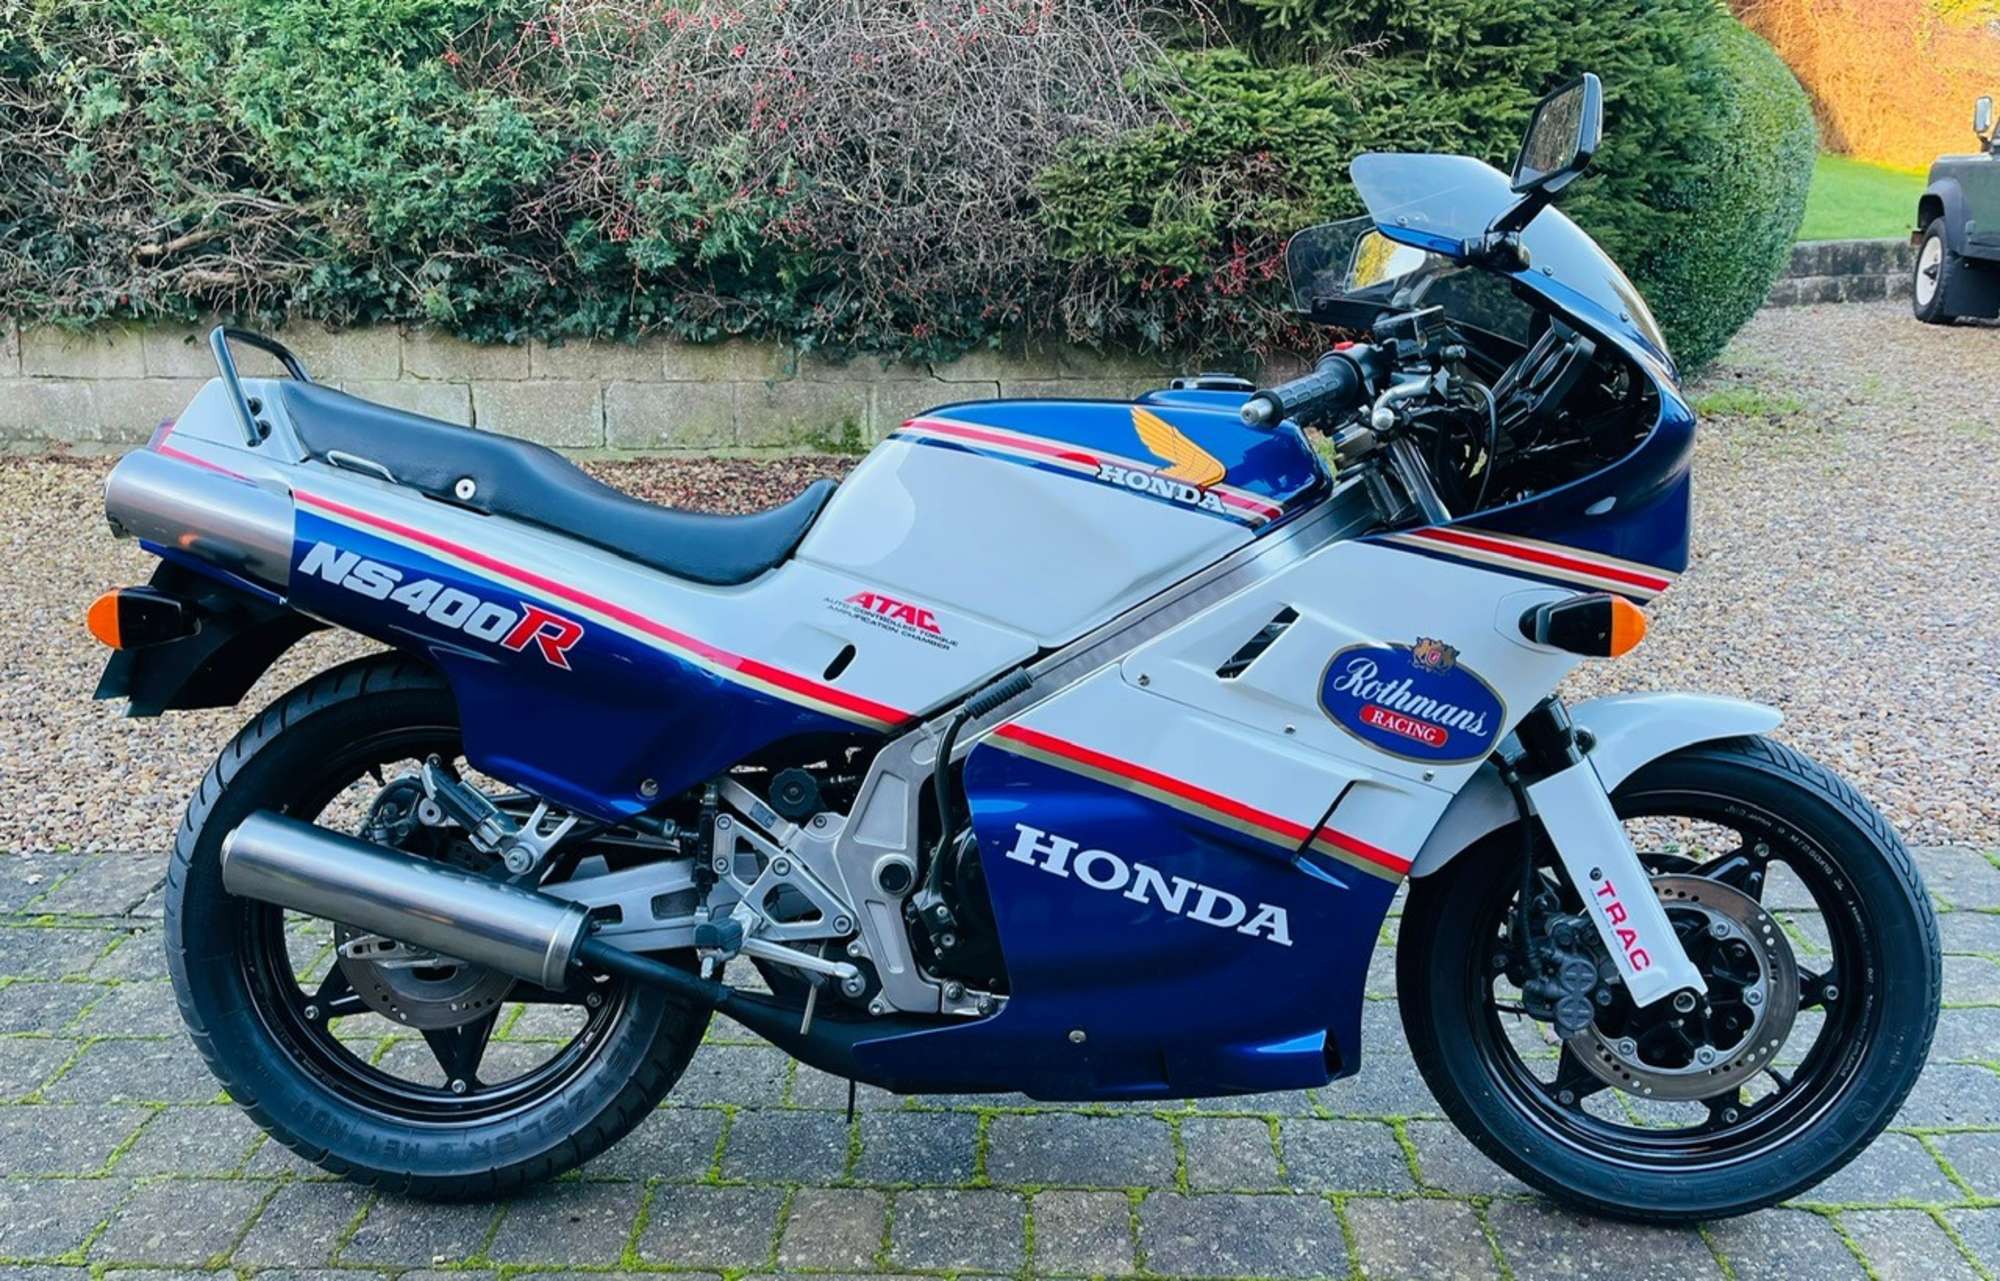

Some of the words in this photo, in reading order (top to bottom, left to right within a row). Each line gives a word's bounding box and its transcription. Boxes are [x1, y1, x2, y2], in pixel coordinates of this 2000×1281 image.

[1098, 464, 1227, 513] HONDA
[298, 541, 585, 671] NS400R
[827, 604, 899, 633] AMPLIFICATION
[901, 630, 950, 651] CHAMBER
[843, 591, 941, 634] ATAC
[920, 629, 959, 647] TORQUE
[1333, 658, 1488, 737] Rothmans
[1371, 710, 1437, 742] RACING
[1005, 823, 1293, 947] HONDA
[1597, 880, 1650, 972] TRAC
